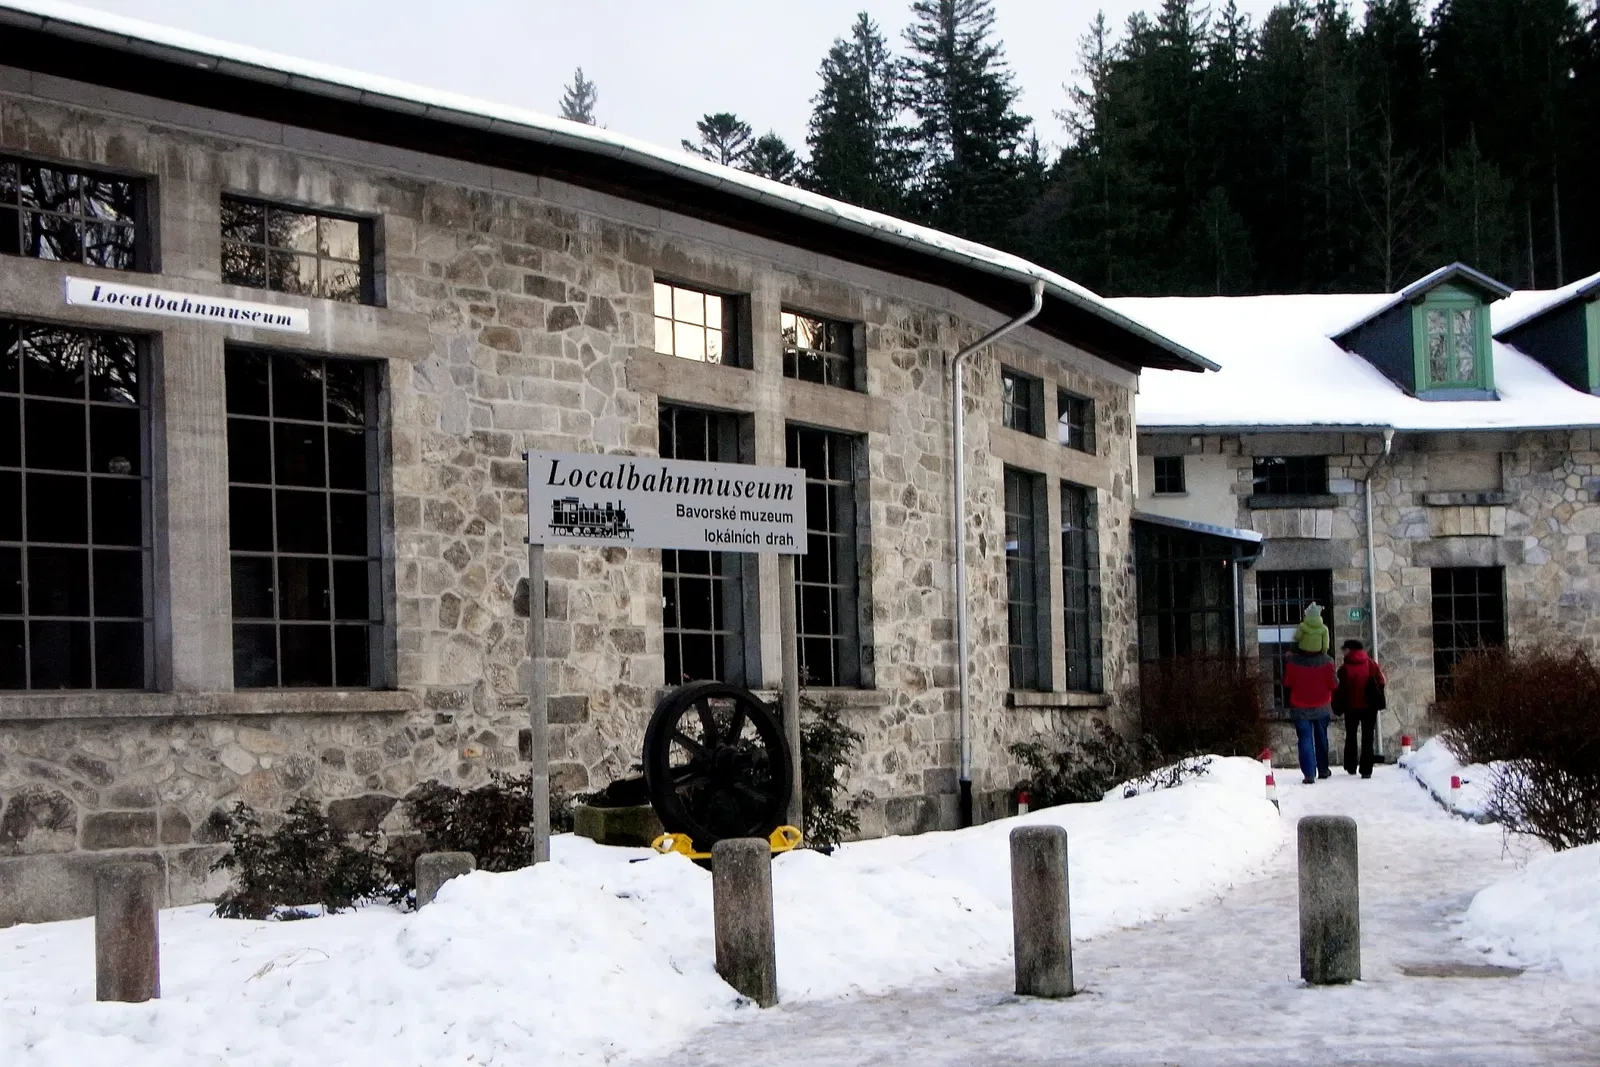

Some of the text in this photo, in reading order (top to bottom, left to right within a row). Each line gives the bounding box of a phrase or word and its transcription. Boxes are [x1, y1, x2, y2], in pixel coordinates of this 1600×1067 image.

[91, 285, 292, 326] Localbahnmuseum
[546, 459, 794, 501] Localbahnmuseum
[676, 503, 794, 524] Bavorské muzeum
[704, 528, 794, 546] lokálních drah
